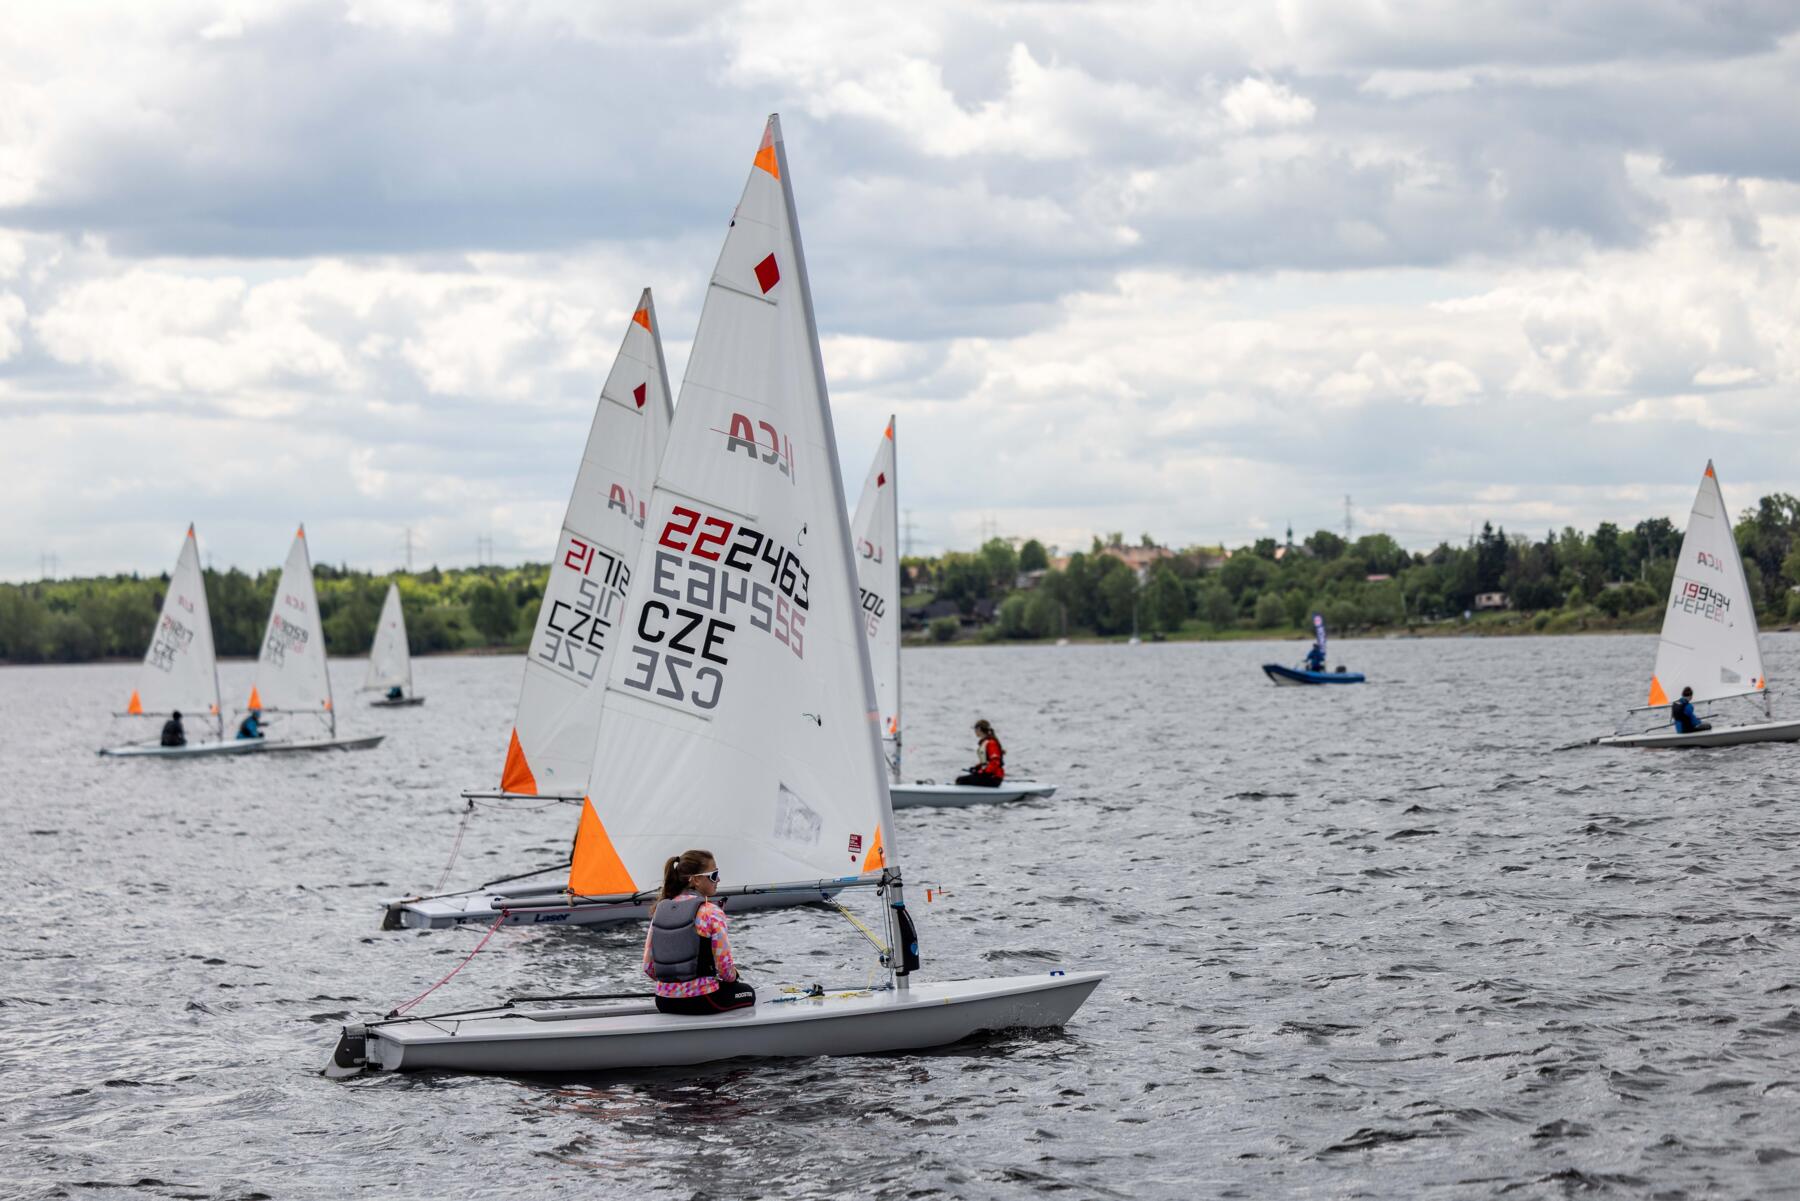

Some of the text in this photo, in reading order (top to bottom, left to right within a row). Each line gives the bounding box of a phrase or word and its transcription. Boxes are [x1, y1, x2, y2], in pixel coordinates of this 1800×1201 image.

[564, 538, 631, 597] 21712
[658, 505, 810, 611] 222463
[1683, 582, 1730, 612] 199434
[547, 600, 611, 650] CZE
[637, 600, 736, 666] CZE
[534, 913, 570, 923] Laser
